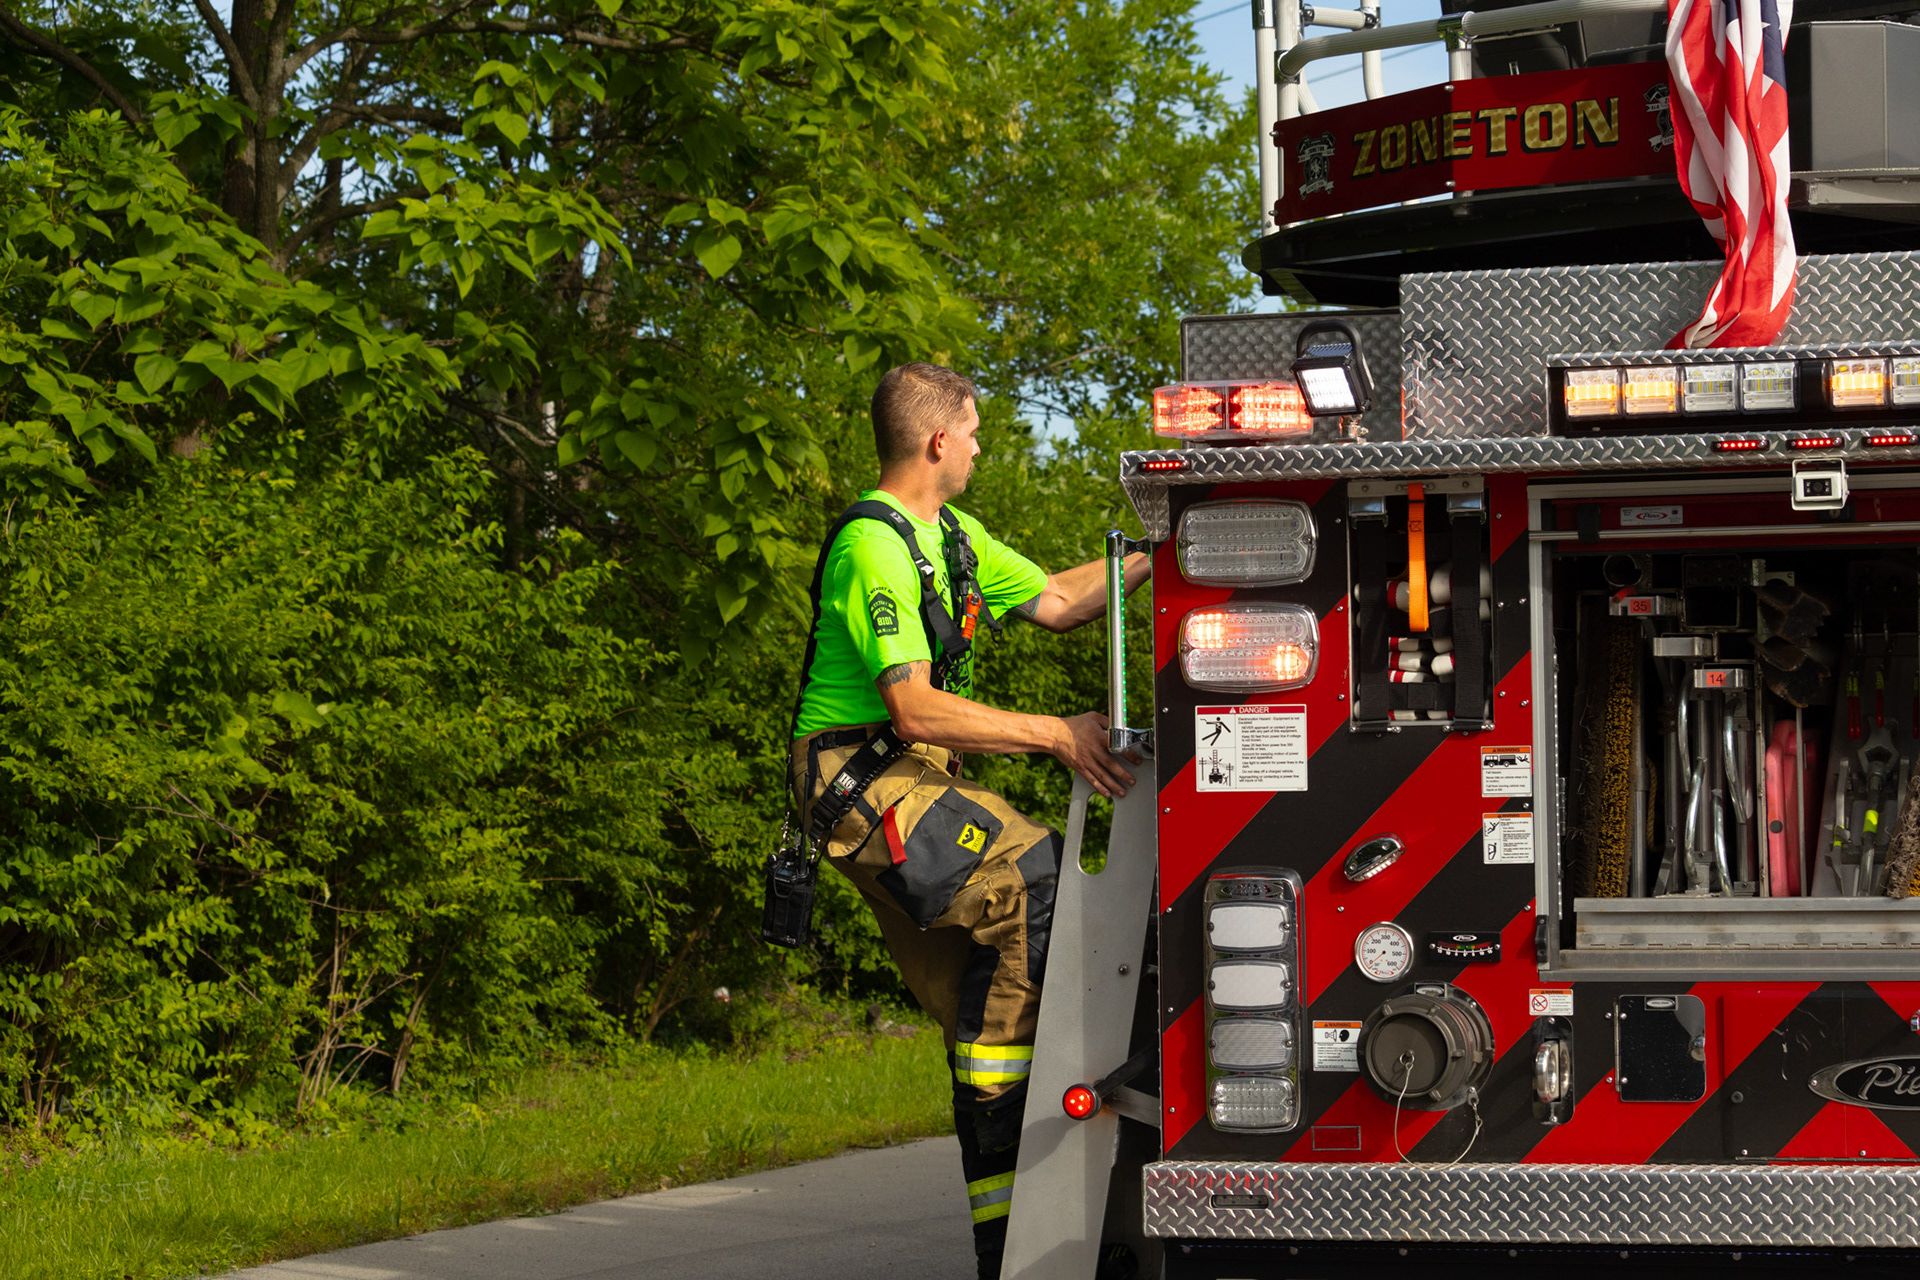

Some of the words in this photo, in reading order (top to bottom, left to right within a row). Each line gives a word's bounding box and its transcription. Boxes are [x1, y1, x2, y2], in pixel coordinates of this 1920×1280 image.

[1351, 96, 1619, 178] ZONETON
[1632, 602, 1648, 612] 35
[1709, 674, 1723, 684] 14
